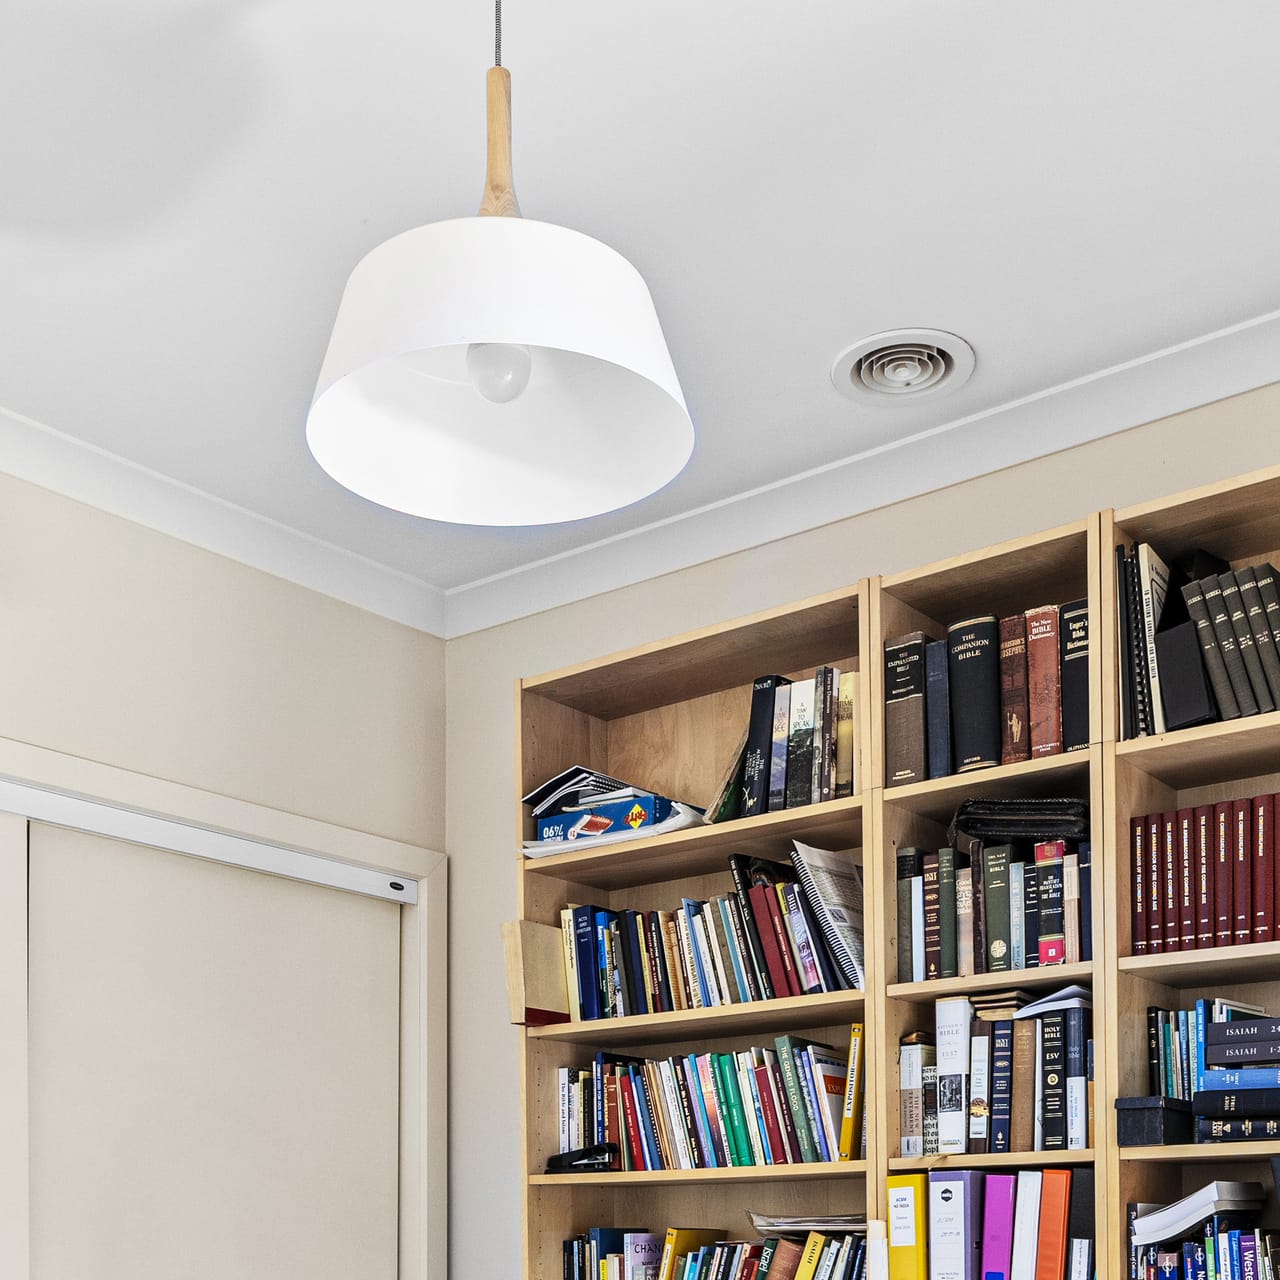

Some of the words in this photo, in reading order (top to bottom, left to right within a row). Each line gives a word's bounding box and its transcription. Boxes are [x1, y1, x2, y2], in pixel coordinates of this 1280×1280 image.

[1032, 625, 1052, 634] BIBLE
[962, 633, 976, 642] THE
[952, 638, 990, 654] COMPANION
[958, 649, 982, 660] BIBLE
[1226, 1026, 1258, 1036] ISAIAH
[1046, 1052, 1060, 1060] ESV
[1226, 1046, 1257, 1057] ISAIAH
[779, 1046, 788, 1059] THE
[788, 1087, 799, 1110] FLOOD
[806, 1239, 818, 1264] ISAIAH
[758, 1246, 772, 1271] Israel
